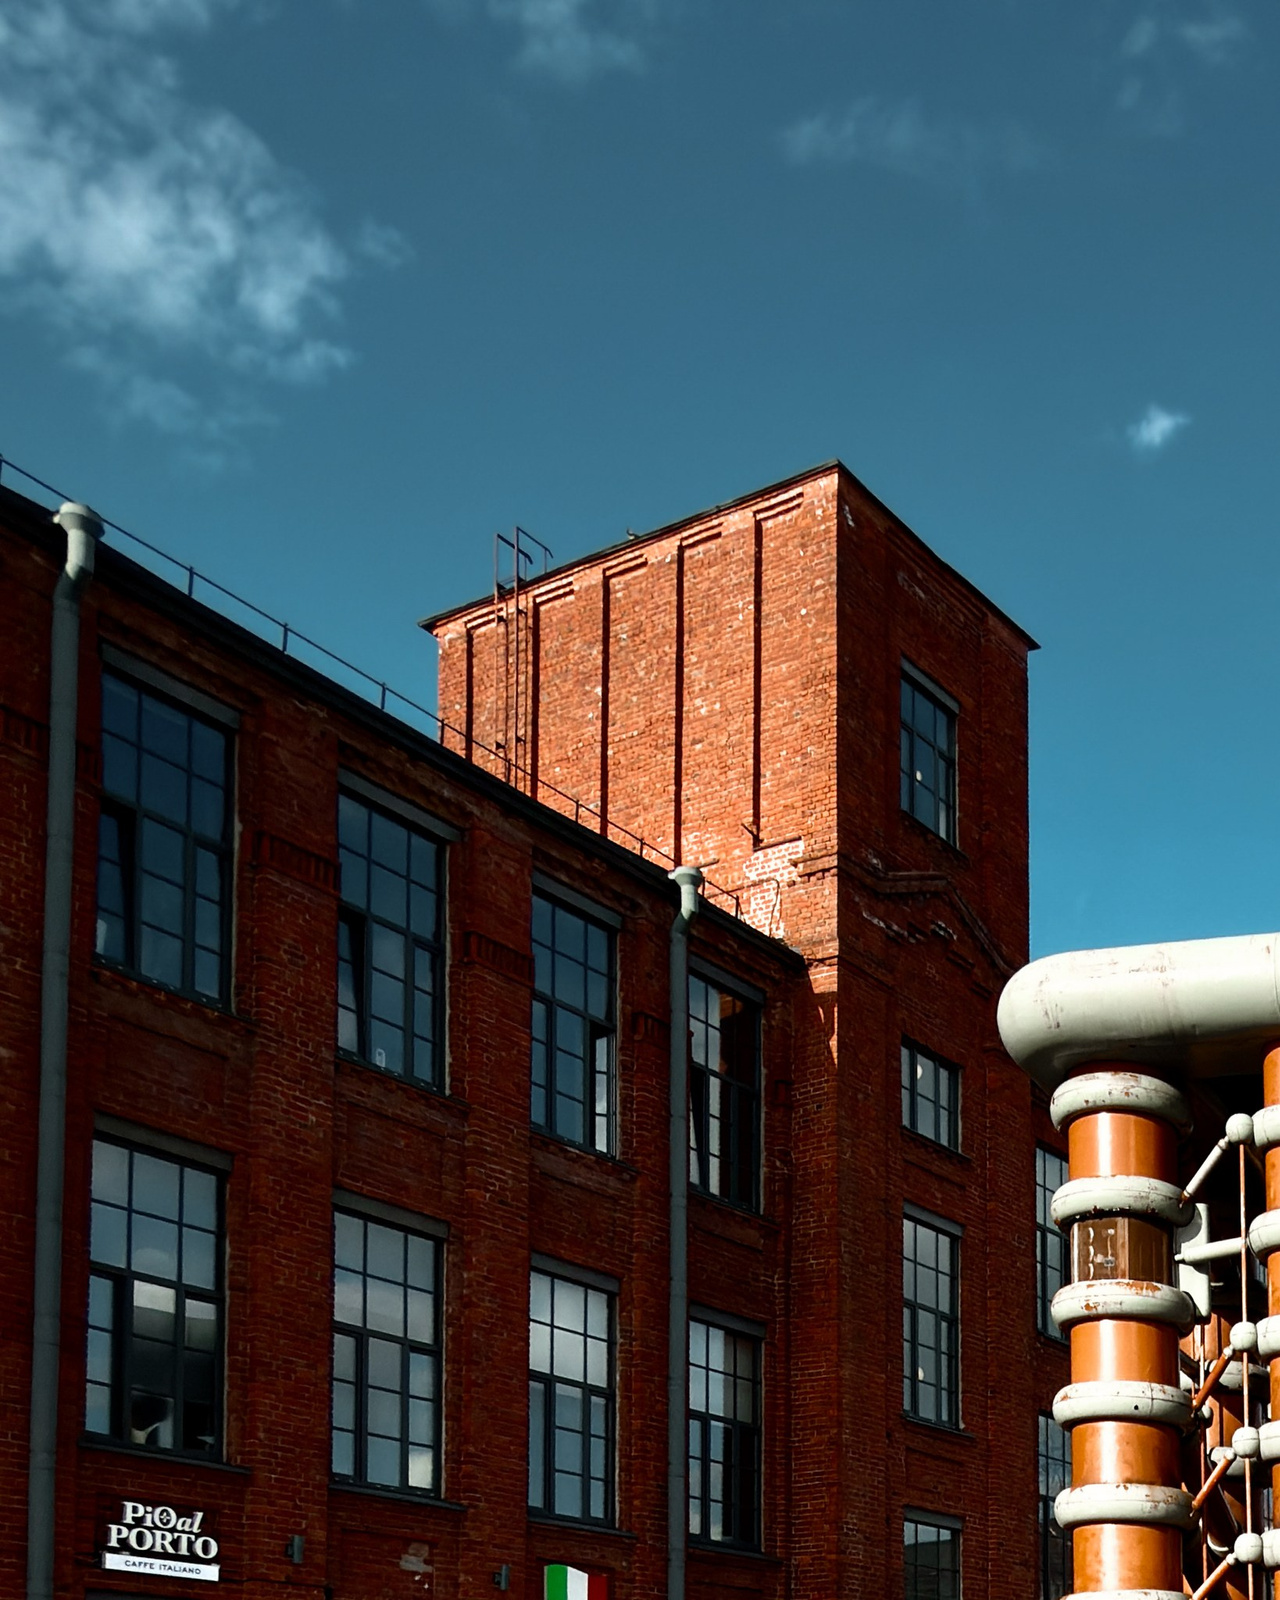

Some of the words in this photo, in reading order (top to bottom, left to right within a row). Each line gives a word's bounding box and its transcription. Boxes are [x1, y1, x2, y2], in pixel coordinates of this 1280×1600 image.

[106, 1524, 218, 1559] PORTO
[124, 1559, 155, 1570] CAFFE
[159, 1563, 202, 1575] ITALIANO
